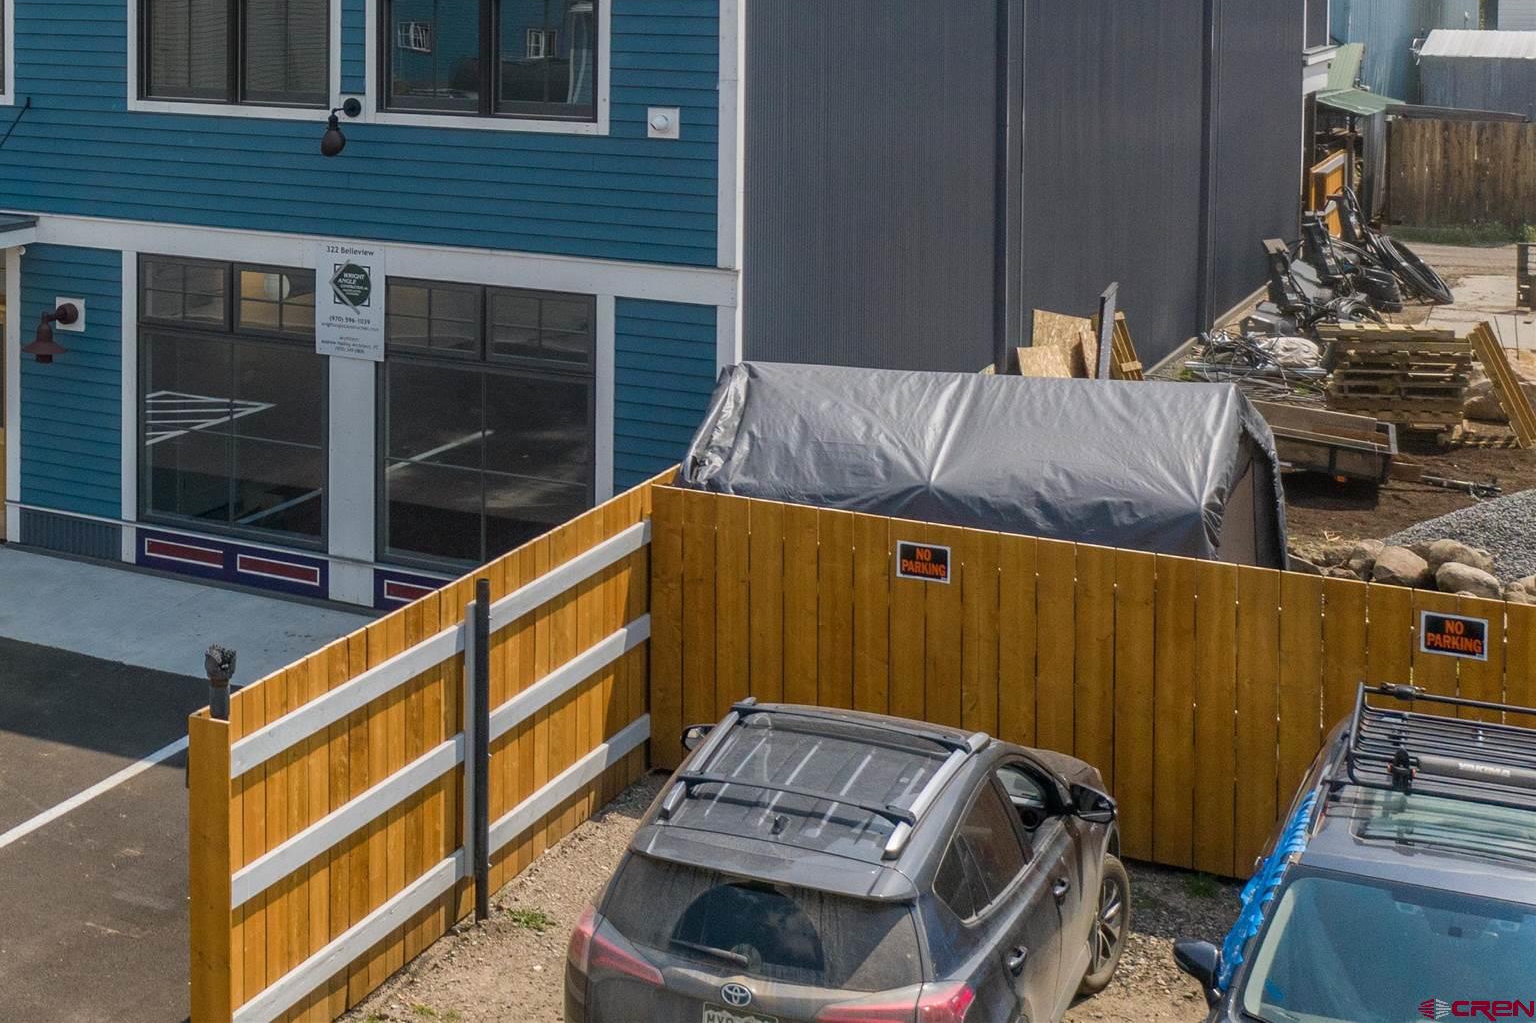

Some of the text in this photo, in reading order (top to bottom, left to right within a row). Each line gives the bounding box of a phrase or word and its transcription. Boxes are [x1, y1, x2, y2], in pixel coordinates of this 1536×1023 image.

[326, 245, 375, 257] 322 Belleview
[916, 548, 932, 562] NO
[901, 559, 946, 577] PARKING
[1445, 619, 1464, 635] NO
[1426, 632, 1482, 653] PARKING
